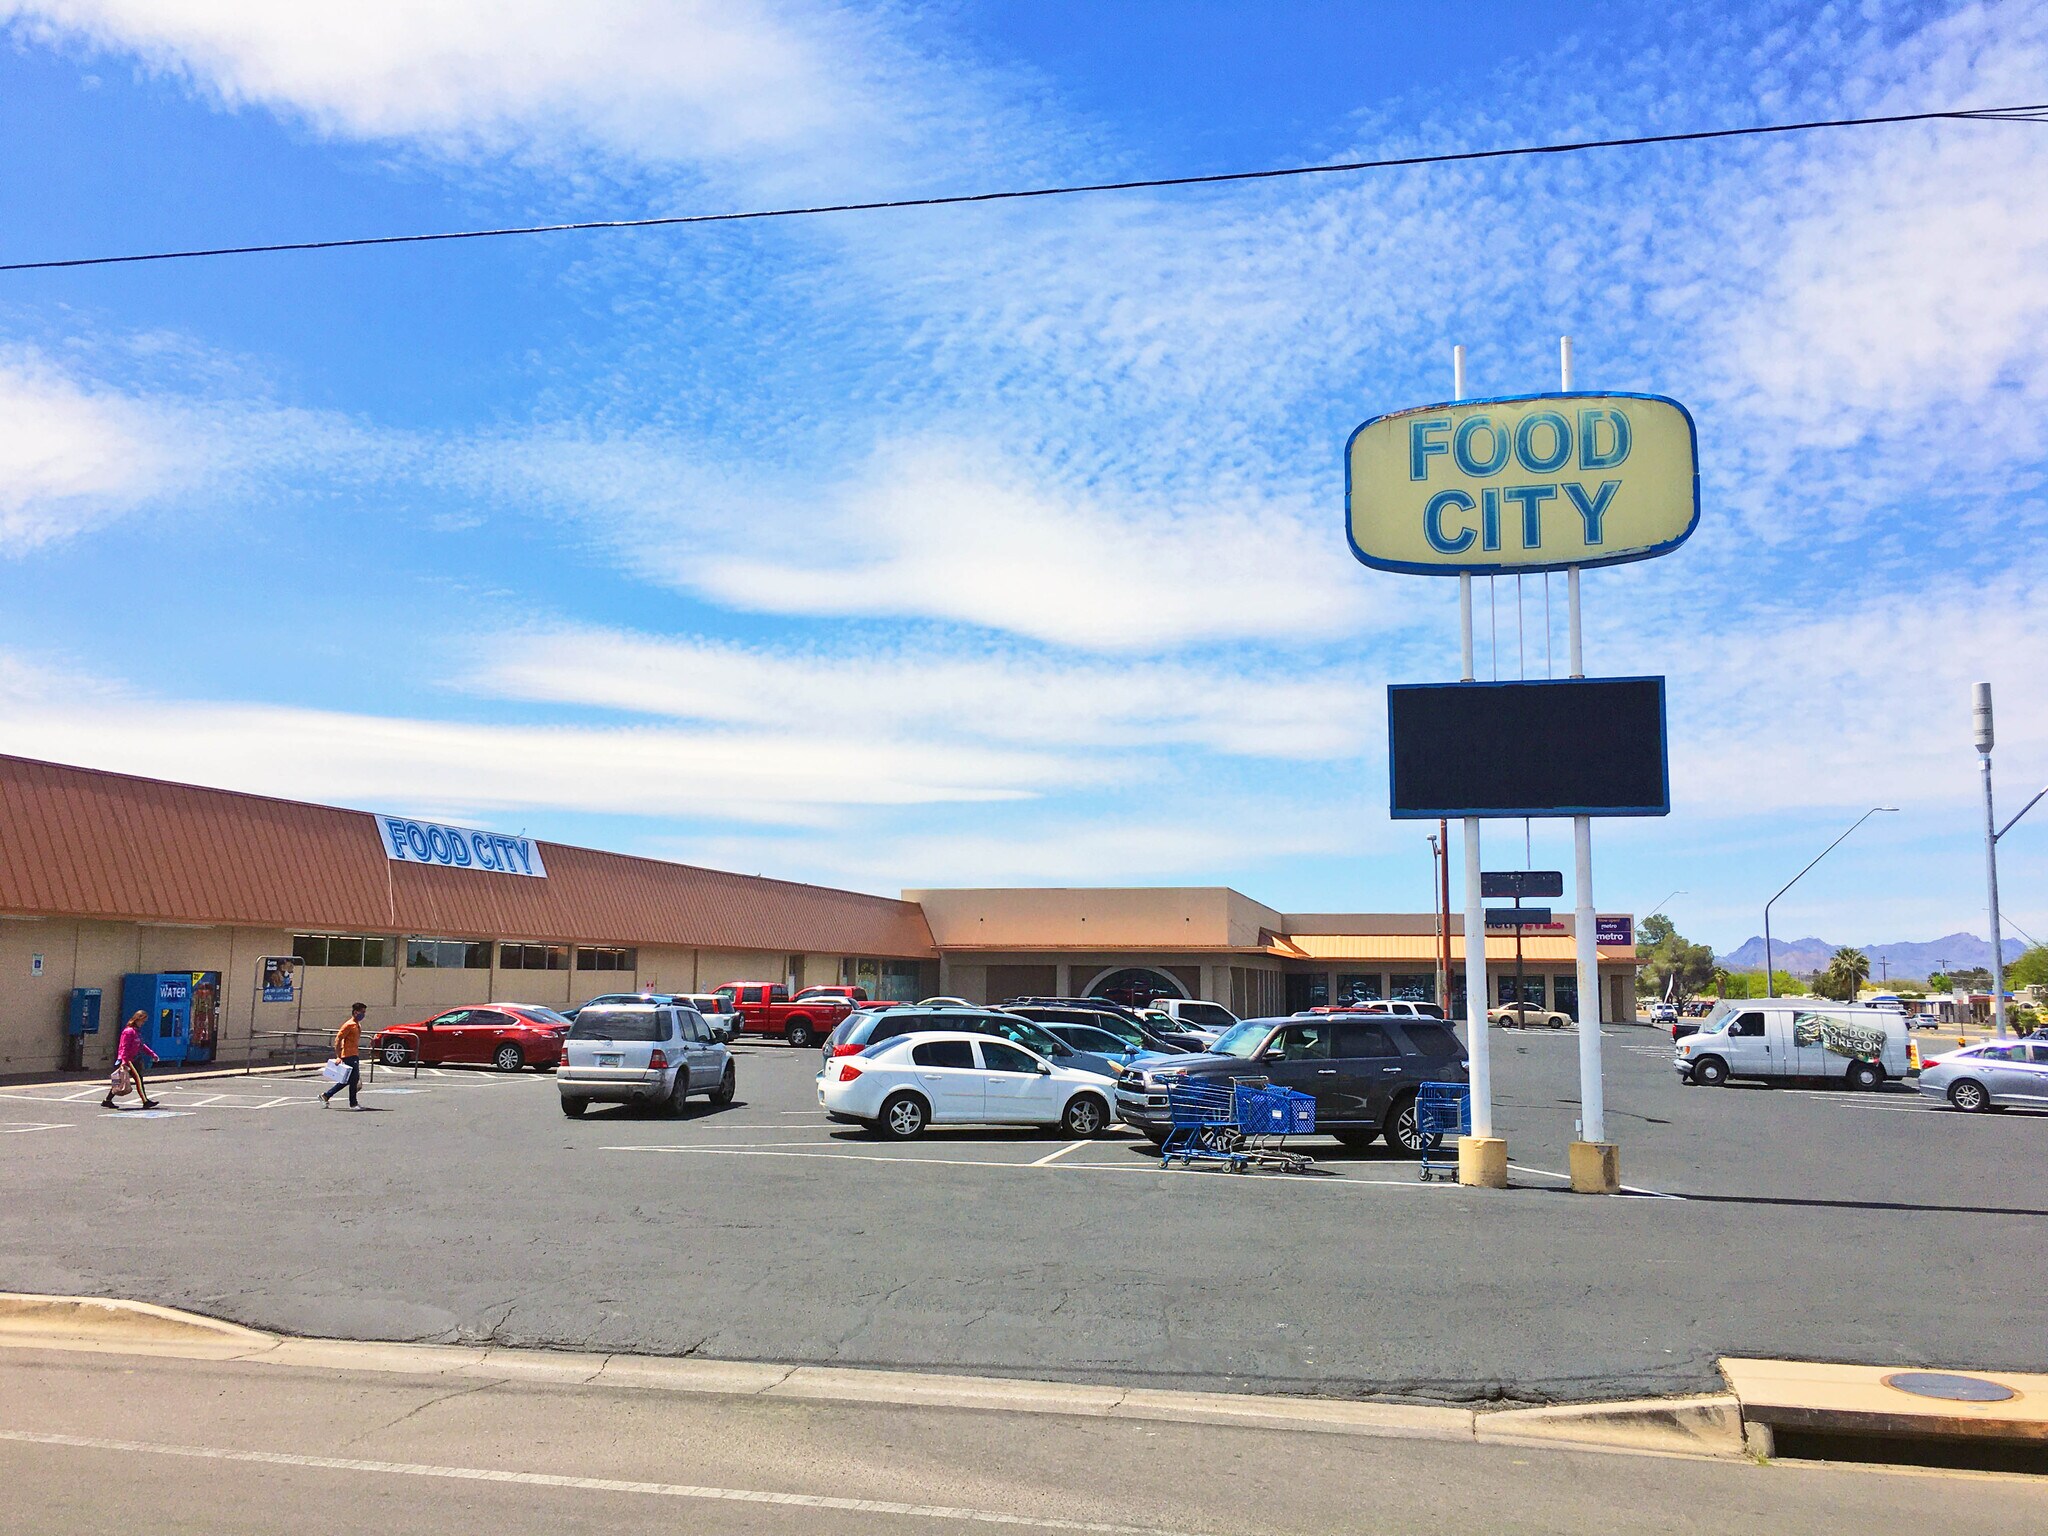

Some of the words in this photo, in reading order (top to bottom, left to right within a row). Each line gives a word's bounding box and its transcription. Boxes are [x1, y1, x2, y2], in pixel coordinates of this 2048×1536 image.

[1409, 407, 1633, 482] FOOD
[1423, 480, 1623, 555] CITY
[385, 818, 471, 866] FOOD
[471, 832, 533, 875] CITY
[1596, 932, 1623, 943] metro
[160, 987, 187, 998] WATER
[1848, 1028, 1883, 1041] DOGS
